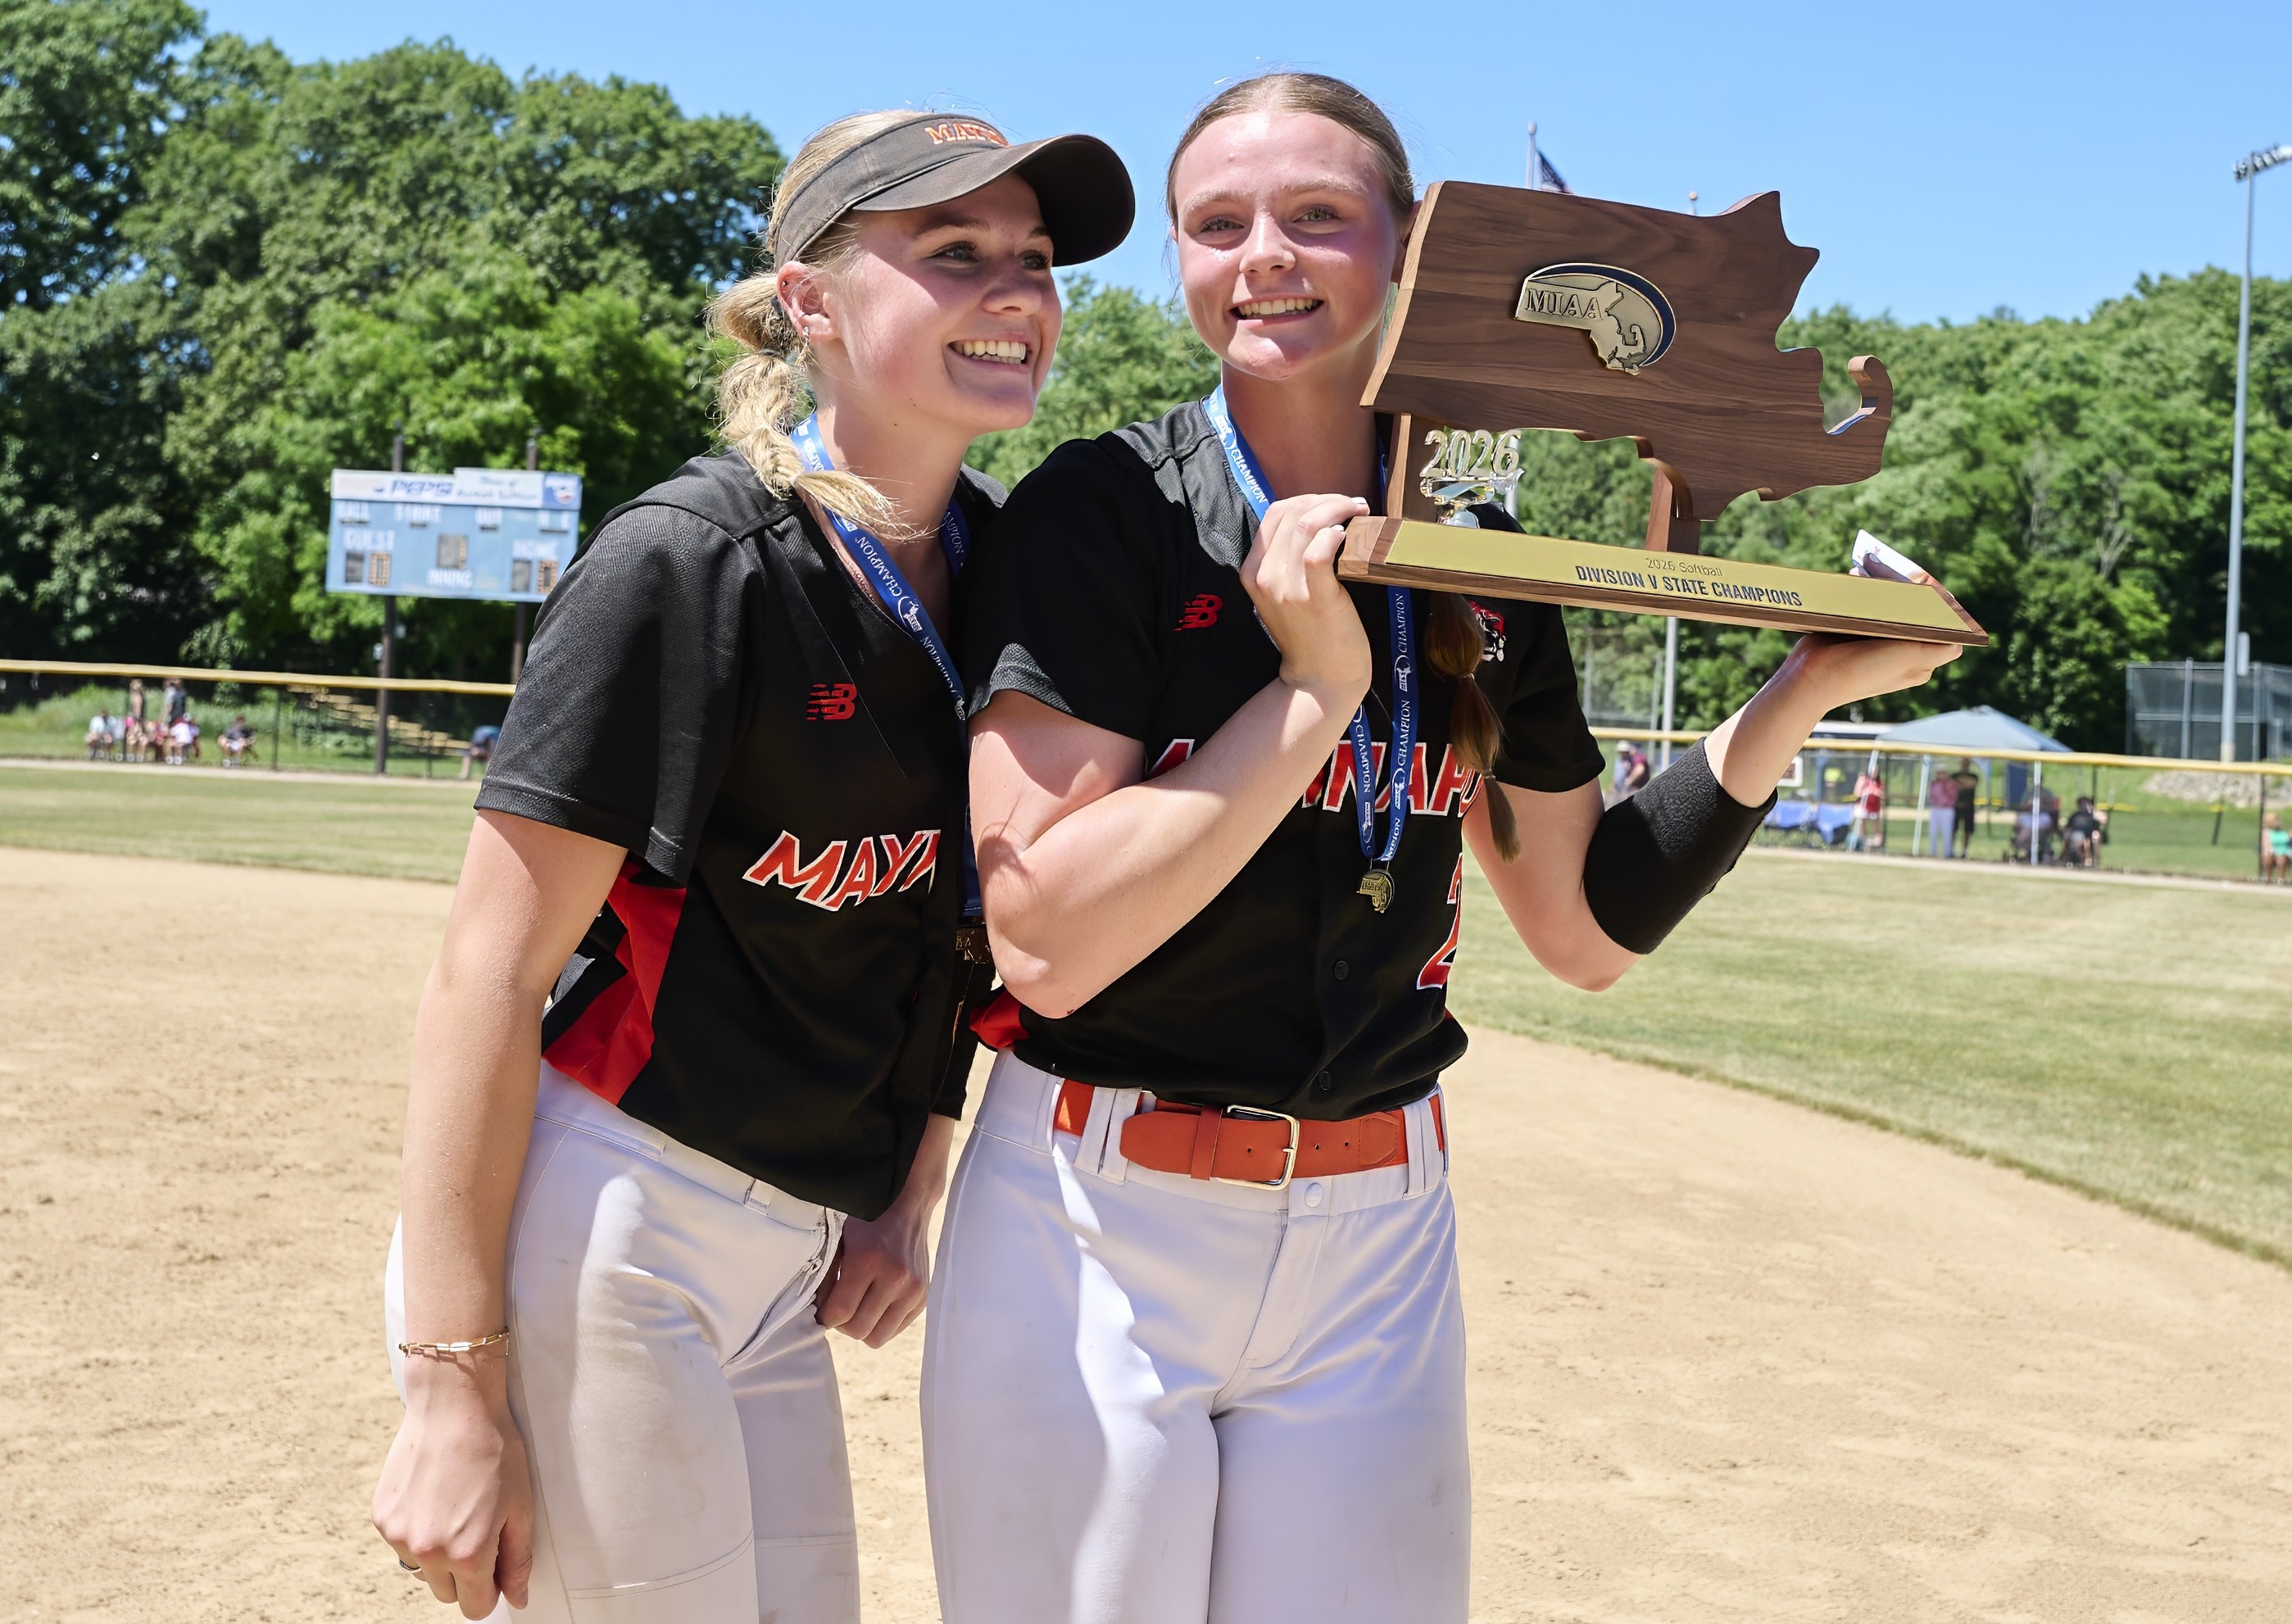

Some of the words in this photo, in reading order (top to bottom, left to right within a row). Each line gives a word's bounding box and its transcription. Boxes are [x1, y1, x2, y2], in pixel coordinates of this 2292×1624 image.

[1525, 288, 1604, 320] MIAA
[1231, 449, 1269, 503] CHAMPION
[1419, 429, 1522, 478] 2026
[856, 537, 902, 597] CHAMPION
[1575, 565, 1645, 588] DIVISION
[1647, 574, 1658, 590] V
[1662, 576, 1709, 597] STATE
[1710, 582, 1803, 607] CHAMPIONS
[1645, 557, 1676, 571] 2026
[1397, 594, 1405, 653] CHAMPION
[1355, 724, 1371, 793] CHAMPION
[1397, 701, 1410, 767] CHAMPION
